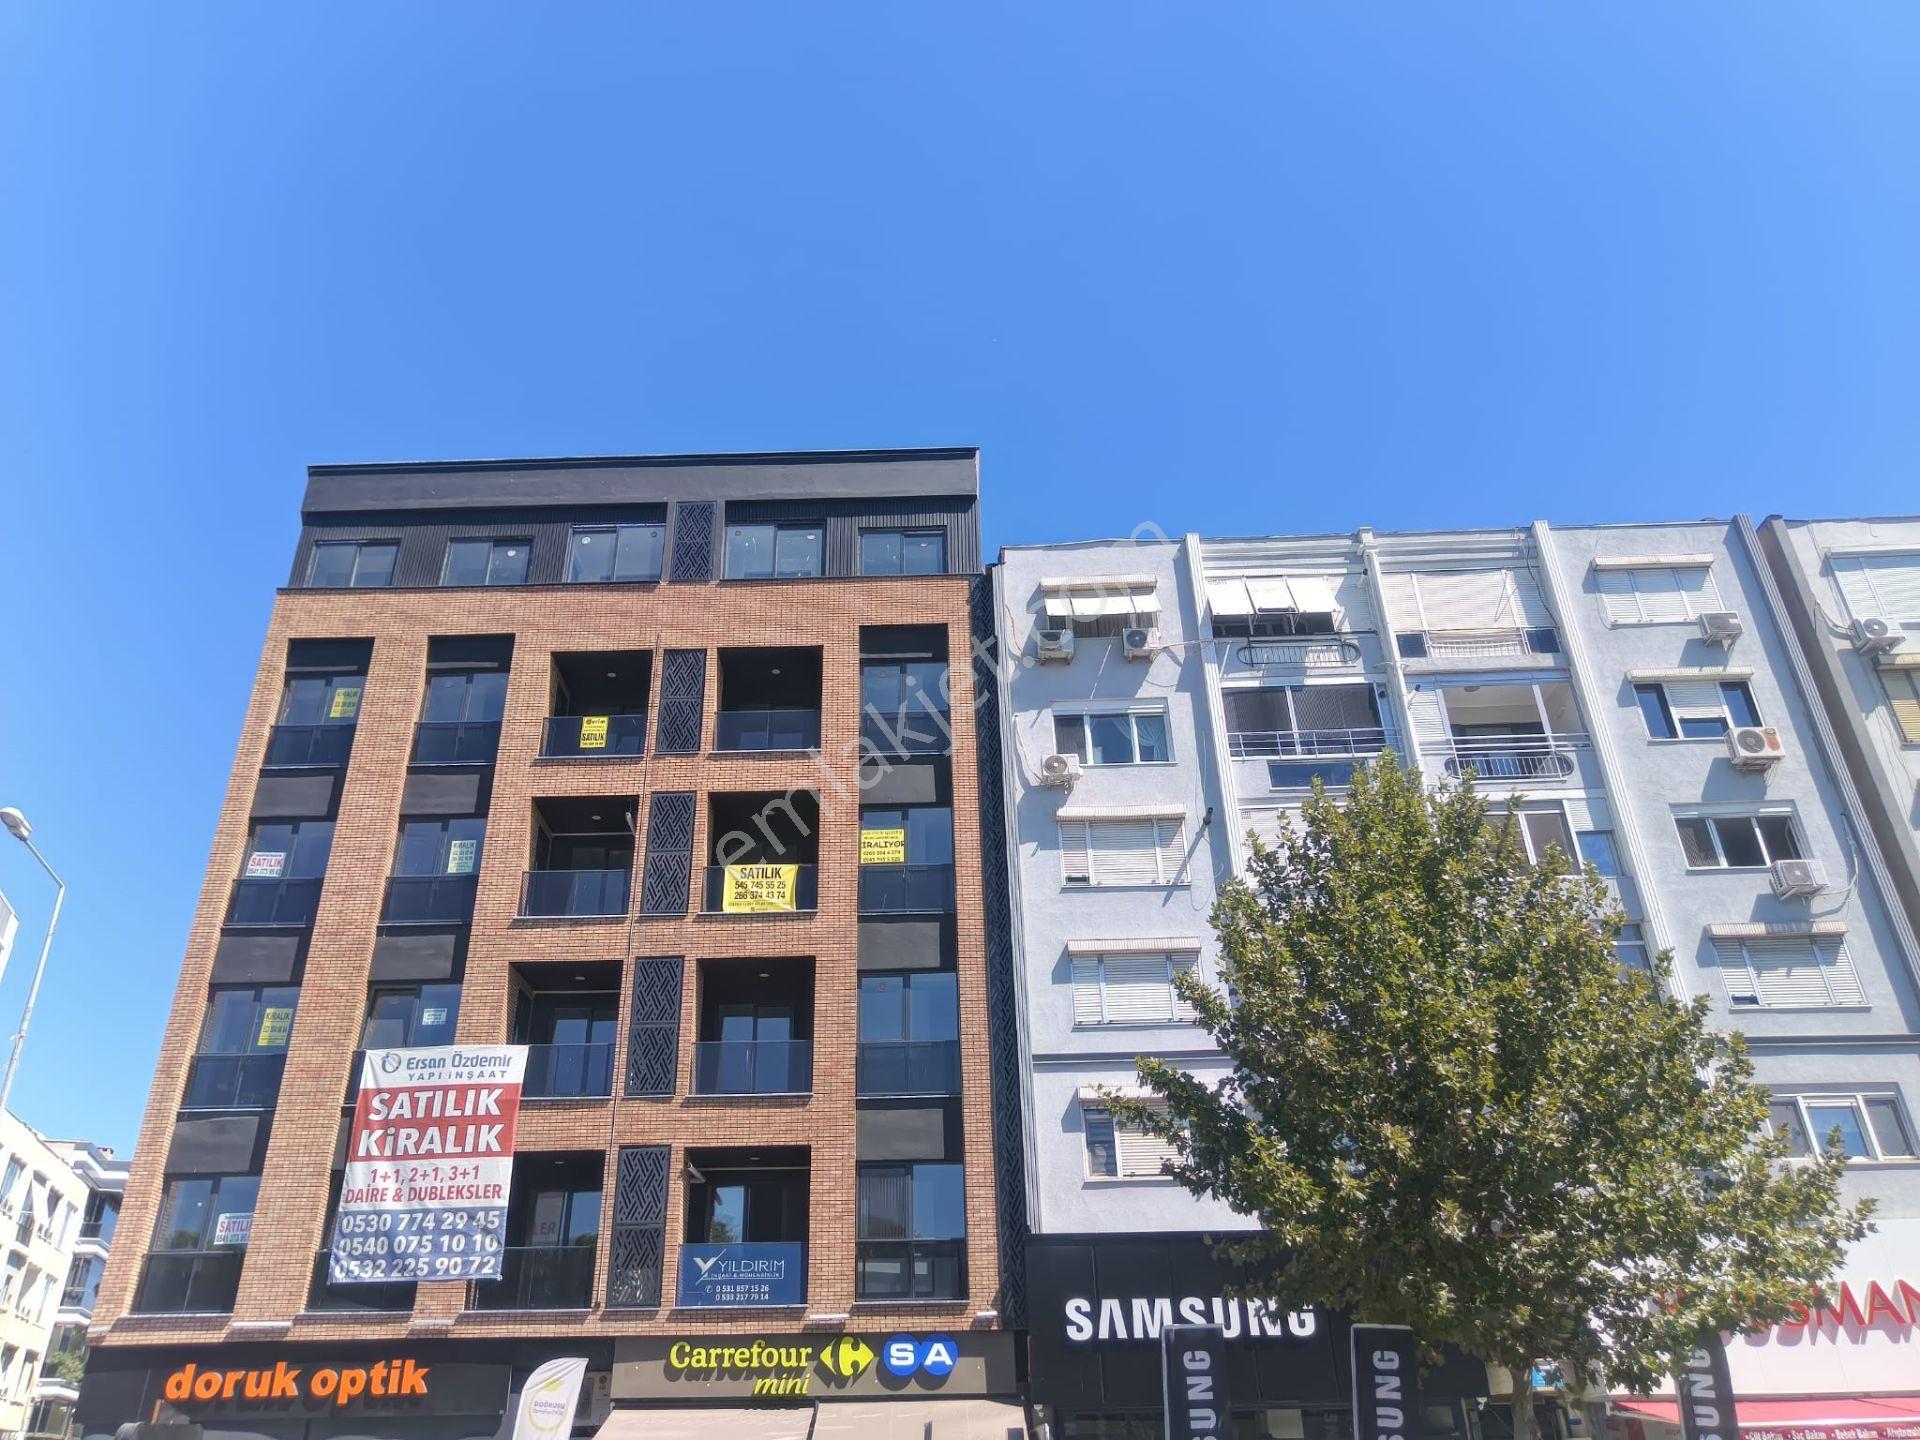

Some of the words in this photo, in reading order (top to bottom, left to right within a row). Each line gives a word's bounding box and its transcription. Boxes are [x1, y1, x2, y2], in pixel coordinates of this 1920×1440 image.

[582, 733, 604, 741] SATILIK
[251, 857, 282, 867] SATILIK
[740, 867, 782, 879] SATILIK
[751, 881, 763, 889] 745
[777, 880, 786, 888] 25
[776, 891, 785, 899] 74
[407, 1056, 446, 1070] Ersan
[452, 1051, 512, 1068] Özdemir
[408, 1073, 442, 1081] YAPI
[368, 1088, 504, 1121] SATILIK
[357, 1124, 504, 1157] KİRALIK
[370, 1169, 405, 1185] 1+1,
[409, 1167, 444, 1183] 2+1,
[449, 1165, 480, 1181] 3+1
[345, 1184, 389, 1204] DAİRE
[392, 1189, 403, 1202] &
[407, 1184, 502, 1201] DUBLEKSLER
[342, 1213, 392, 1234] 0530
[397, 1212, 436, 1231] 774
[441, 1211, 468, 1230] 29
[473, 1210, 500, 1229] 45
[338, 1236, 389, 1256] 0540
[393, 1235, 433, 1254] 075
[440, 1234, 466, 1252] 10
[473, 1233, 498, 1252] 10
[334, 1259, 387, 1279] 0532
[391, 1258, 429, 1277] 225
[435, 1256, 462, 1275] 90
[468, 1255, 496, 1274] 72
[719, 1260, 784, 1272] YILDIRIM
[1065, 1297, 1316, 1341] SAMSUNG
[670, 1340, 812, 1369] Carrefour
[890, 1343, 953, 1366] SA
[165, 1362, 302, 1400] doruk
[310, 1359, 430, 1405] optik
[754, 1373, 810, 1395] mini
[1183, 1351, 1217, 1440] UNG
[1373, 1351, 1404, 1440] UNG
